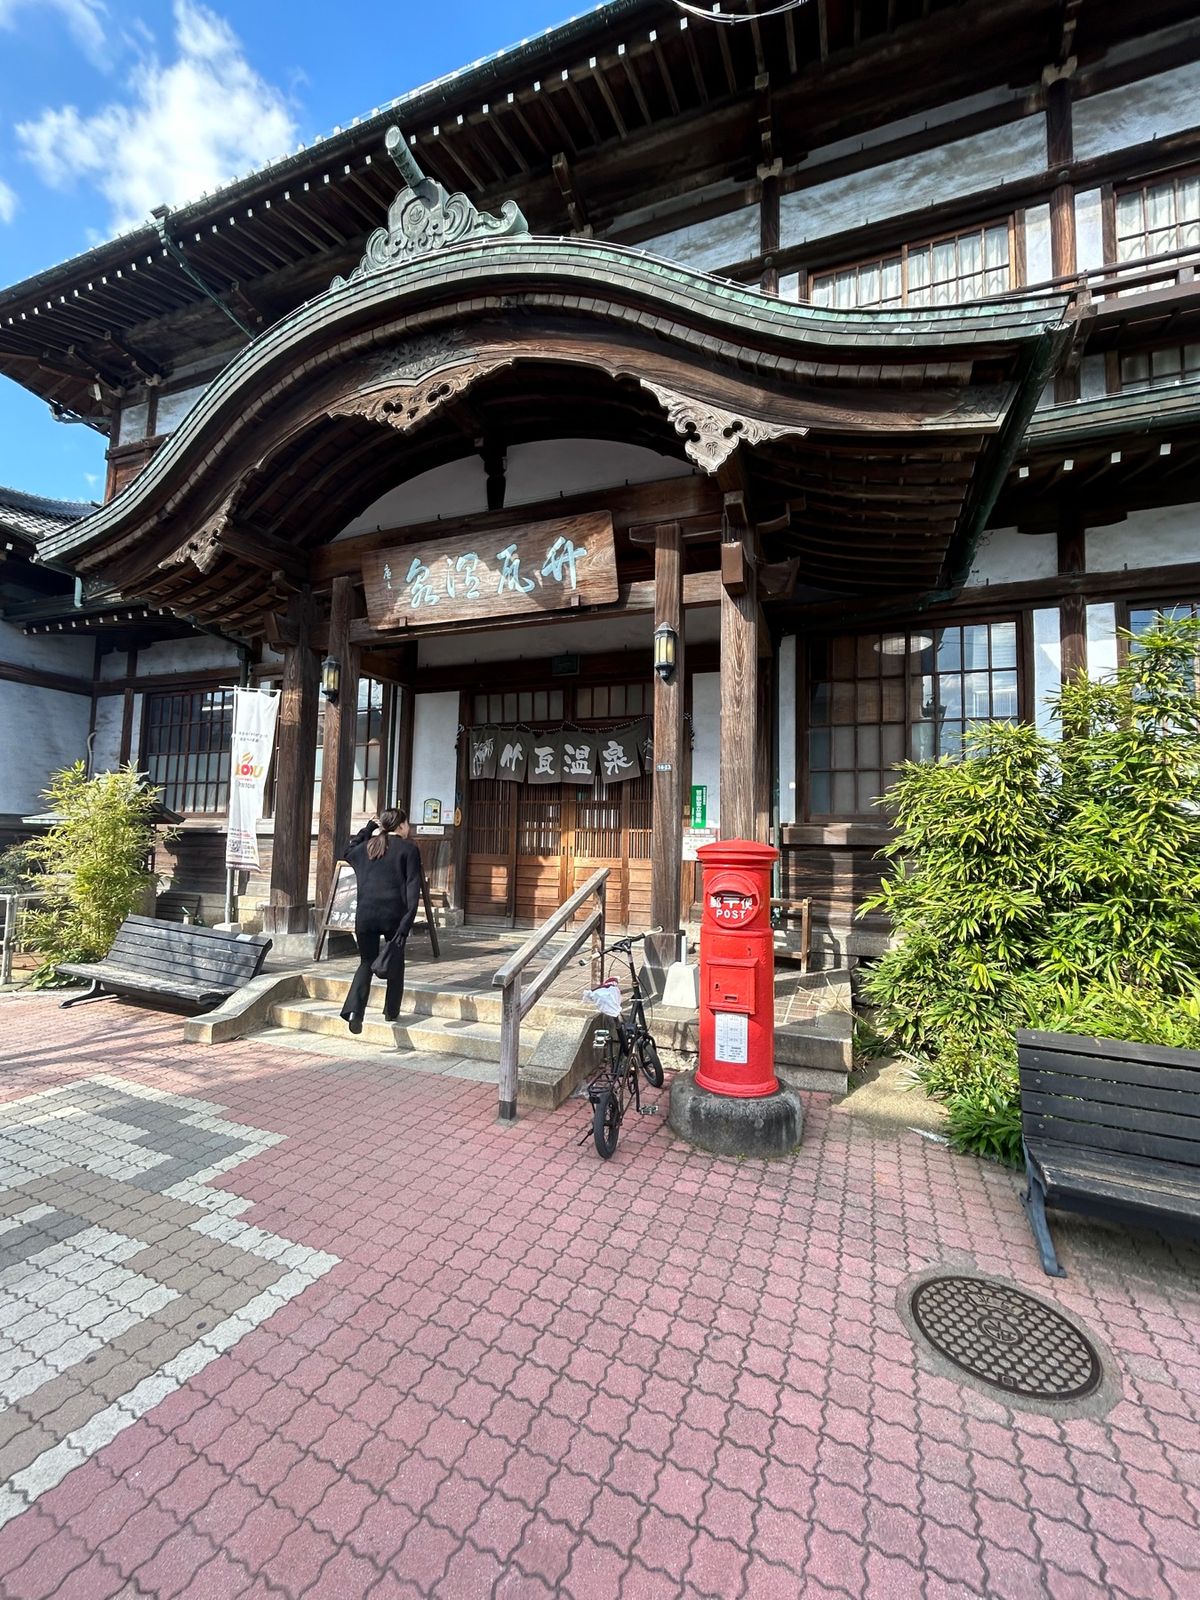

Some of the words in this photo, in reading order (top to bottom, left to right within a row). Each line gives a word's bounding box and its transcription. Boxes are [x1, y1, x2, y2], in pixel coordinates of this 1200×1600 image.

[500, 740, 634, 775] 竹瓦温泉
[716, 909, 747, 919] POST
